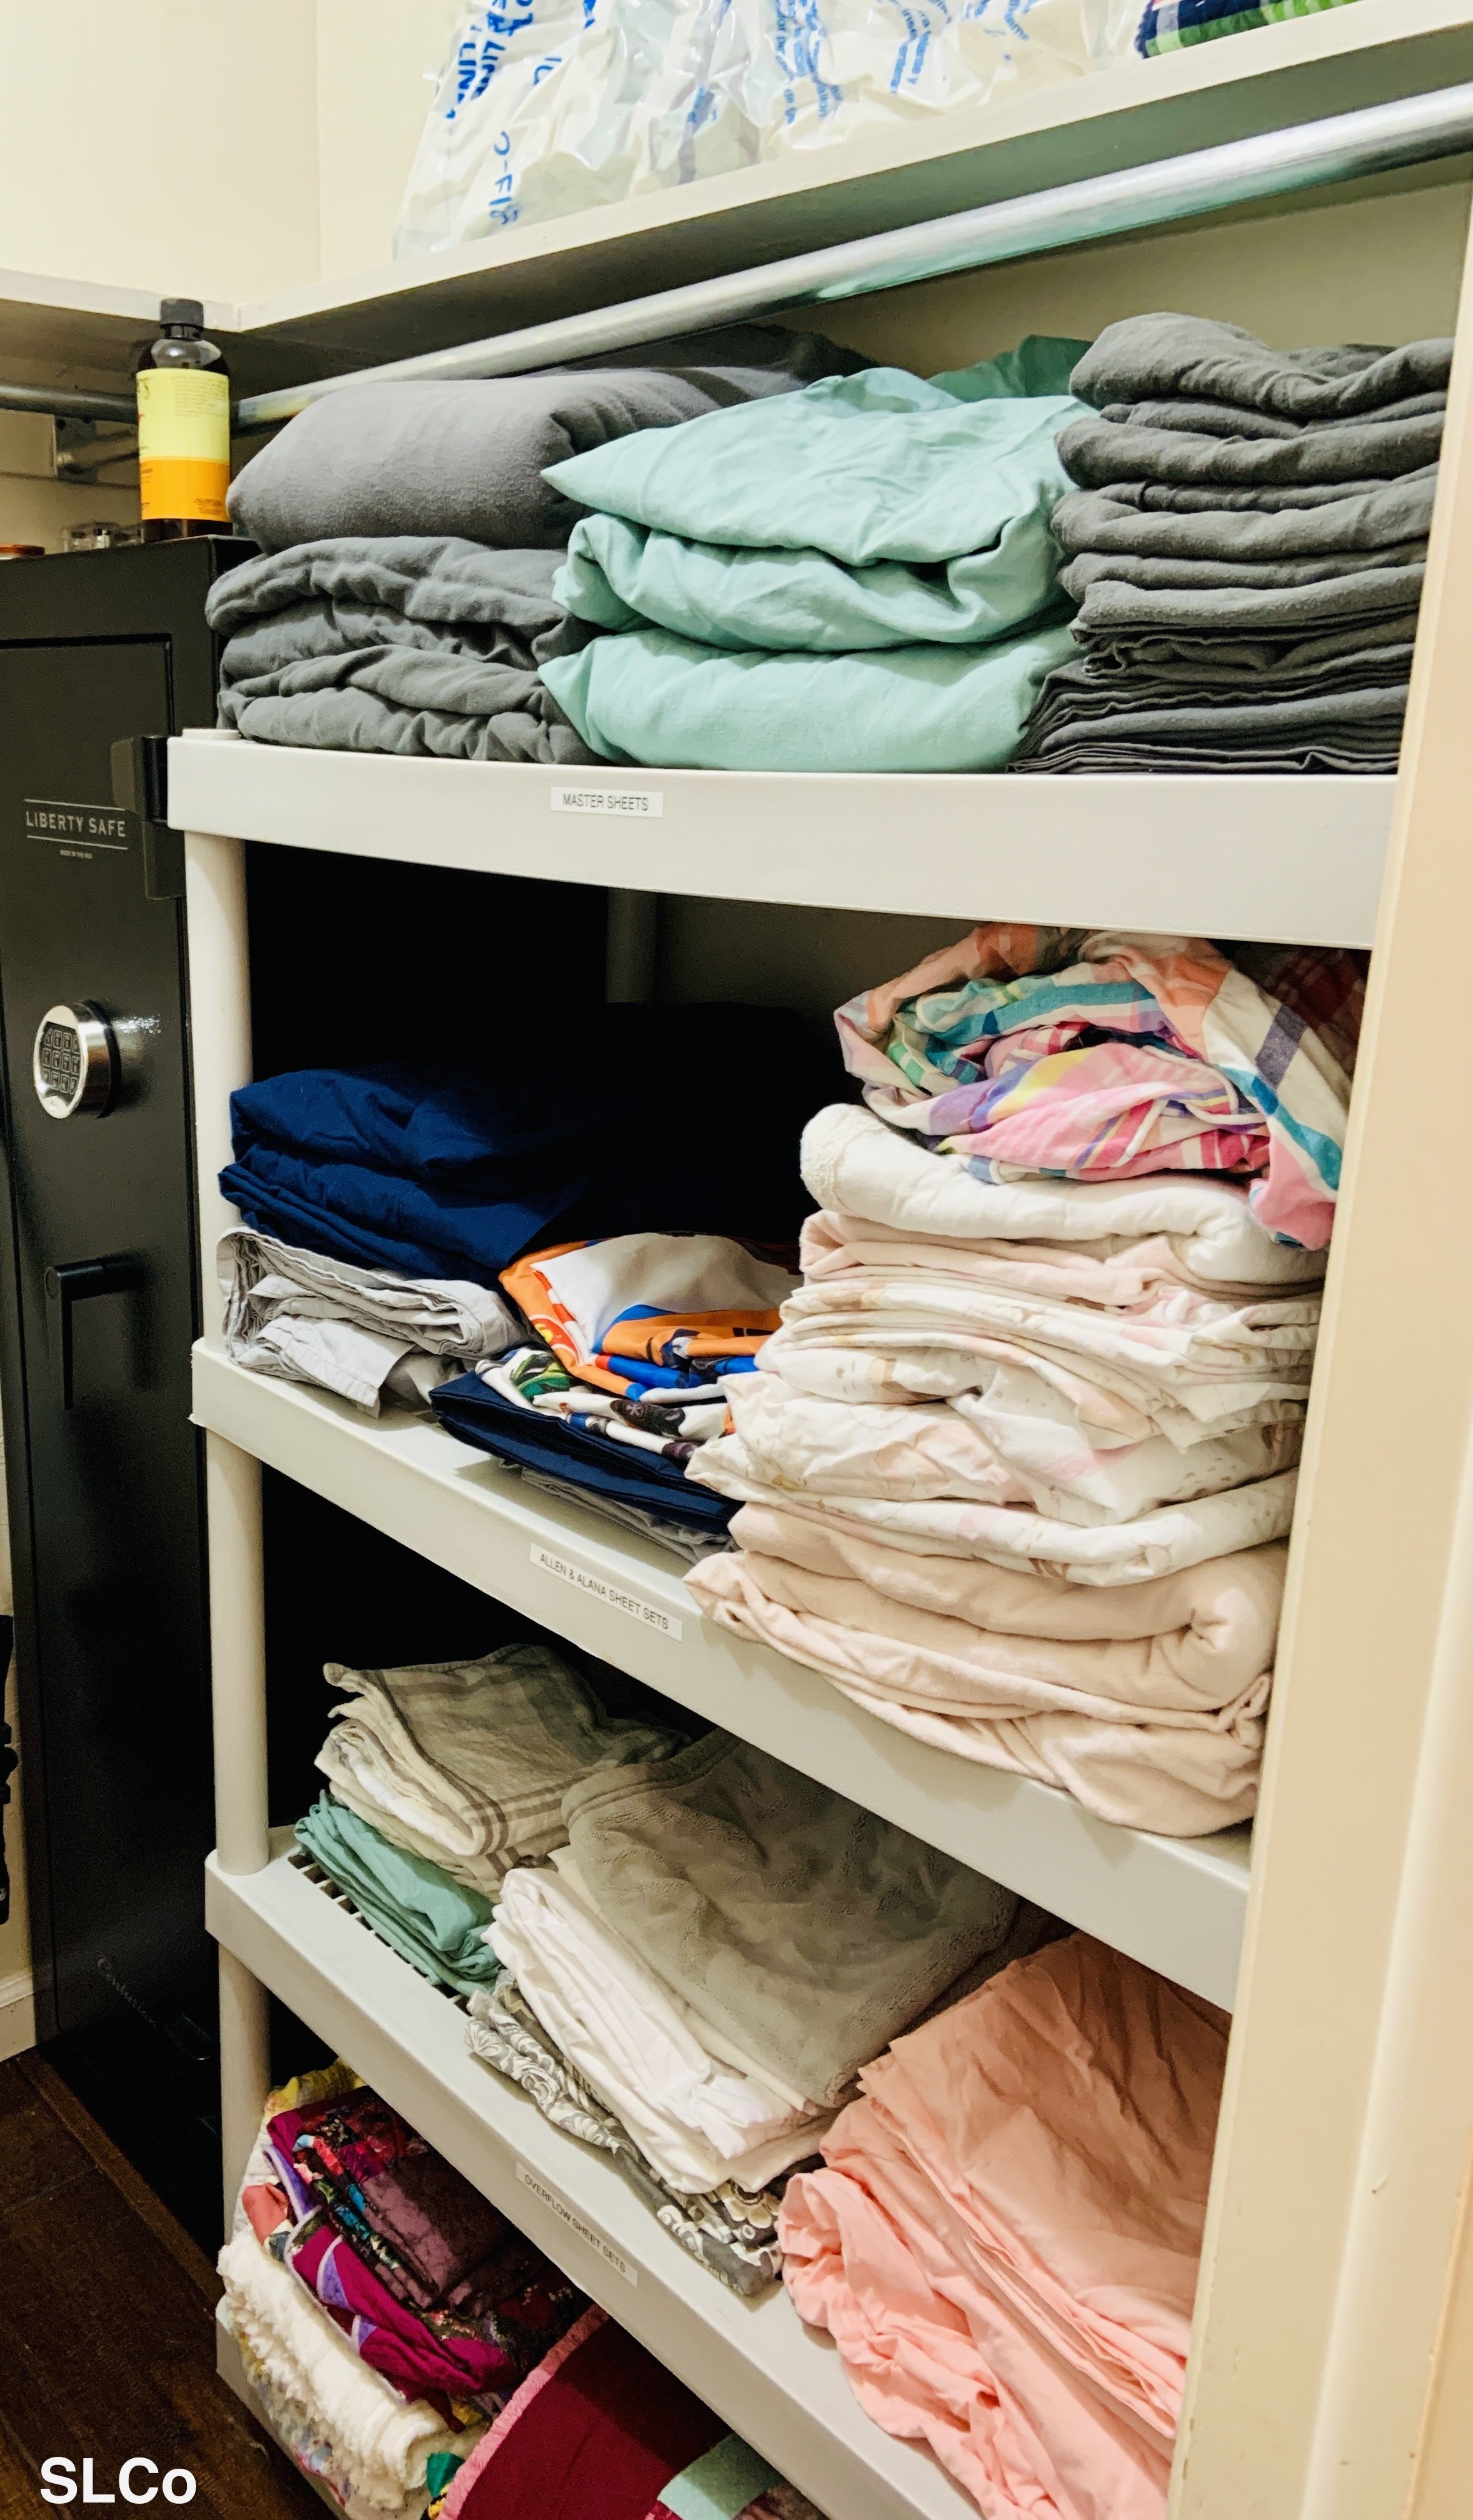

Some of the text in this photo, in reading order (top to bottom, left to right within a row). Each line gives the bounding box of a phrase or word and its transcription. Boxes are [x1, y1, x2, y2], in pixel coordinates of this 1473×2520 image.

[26, 811, 126, 838] LIBERTY SAFE
[563, 793, 649, 811] MASTER SHEETS
[540, 1554, 669, 1629] ALLEN & ALANA SHEET SETS
[525, 2174, 626, 2273] OVERFLOW SHEET SETS
